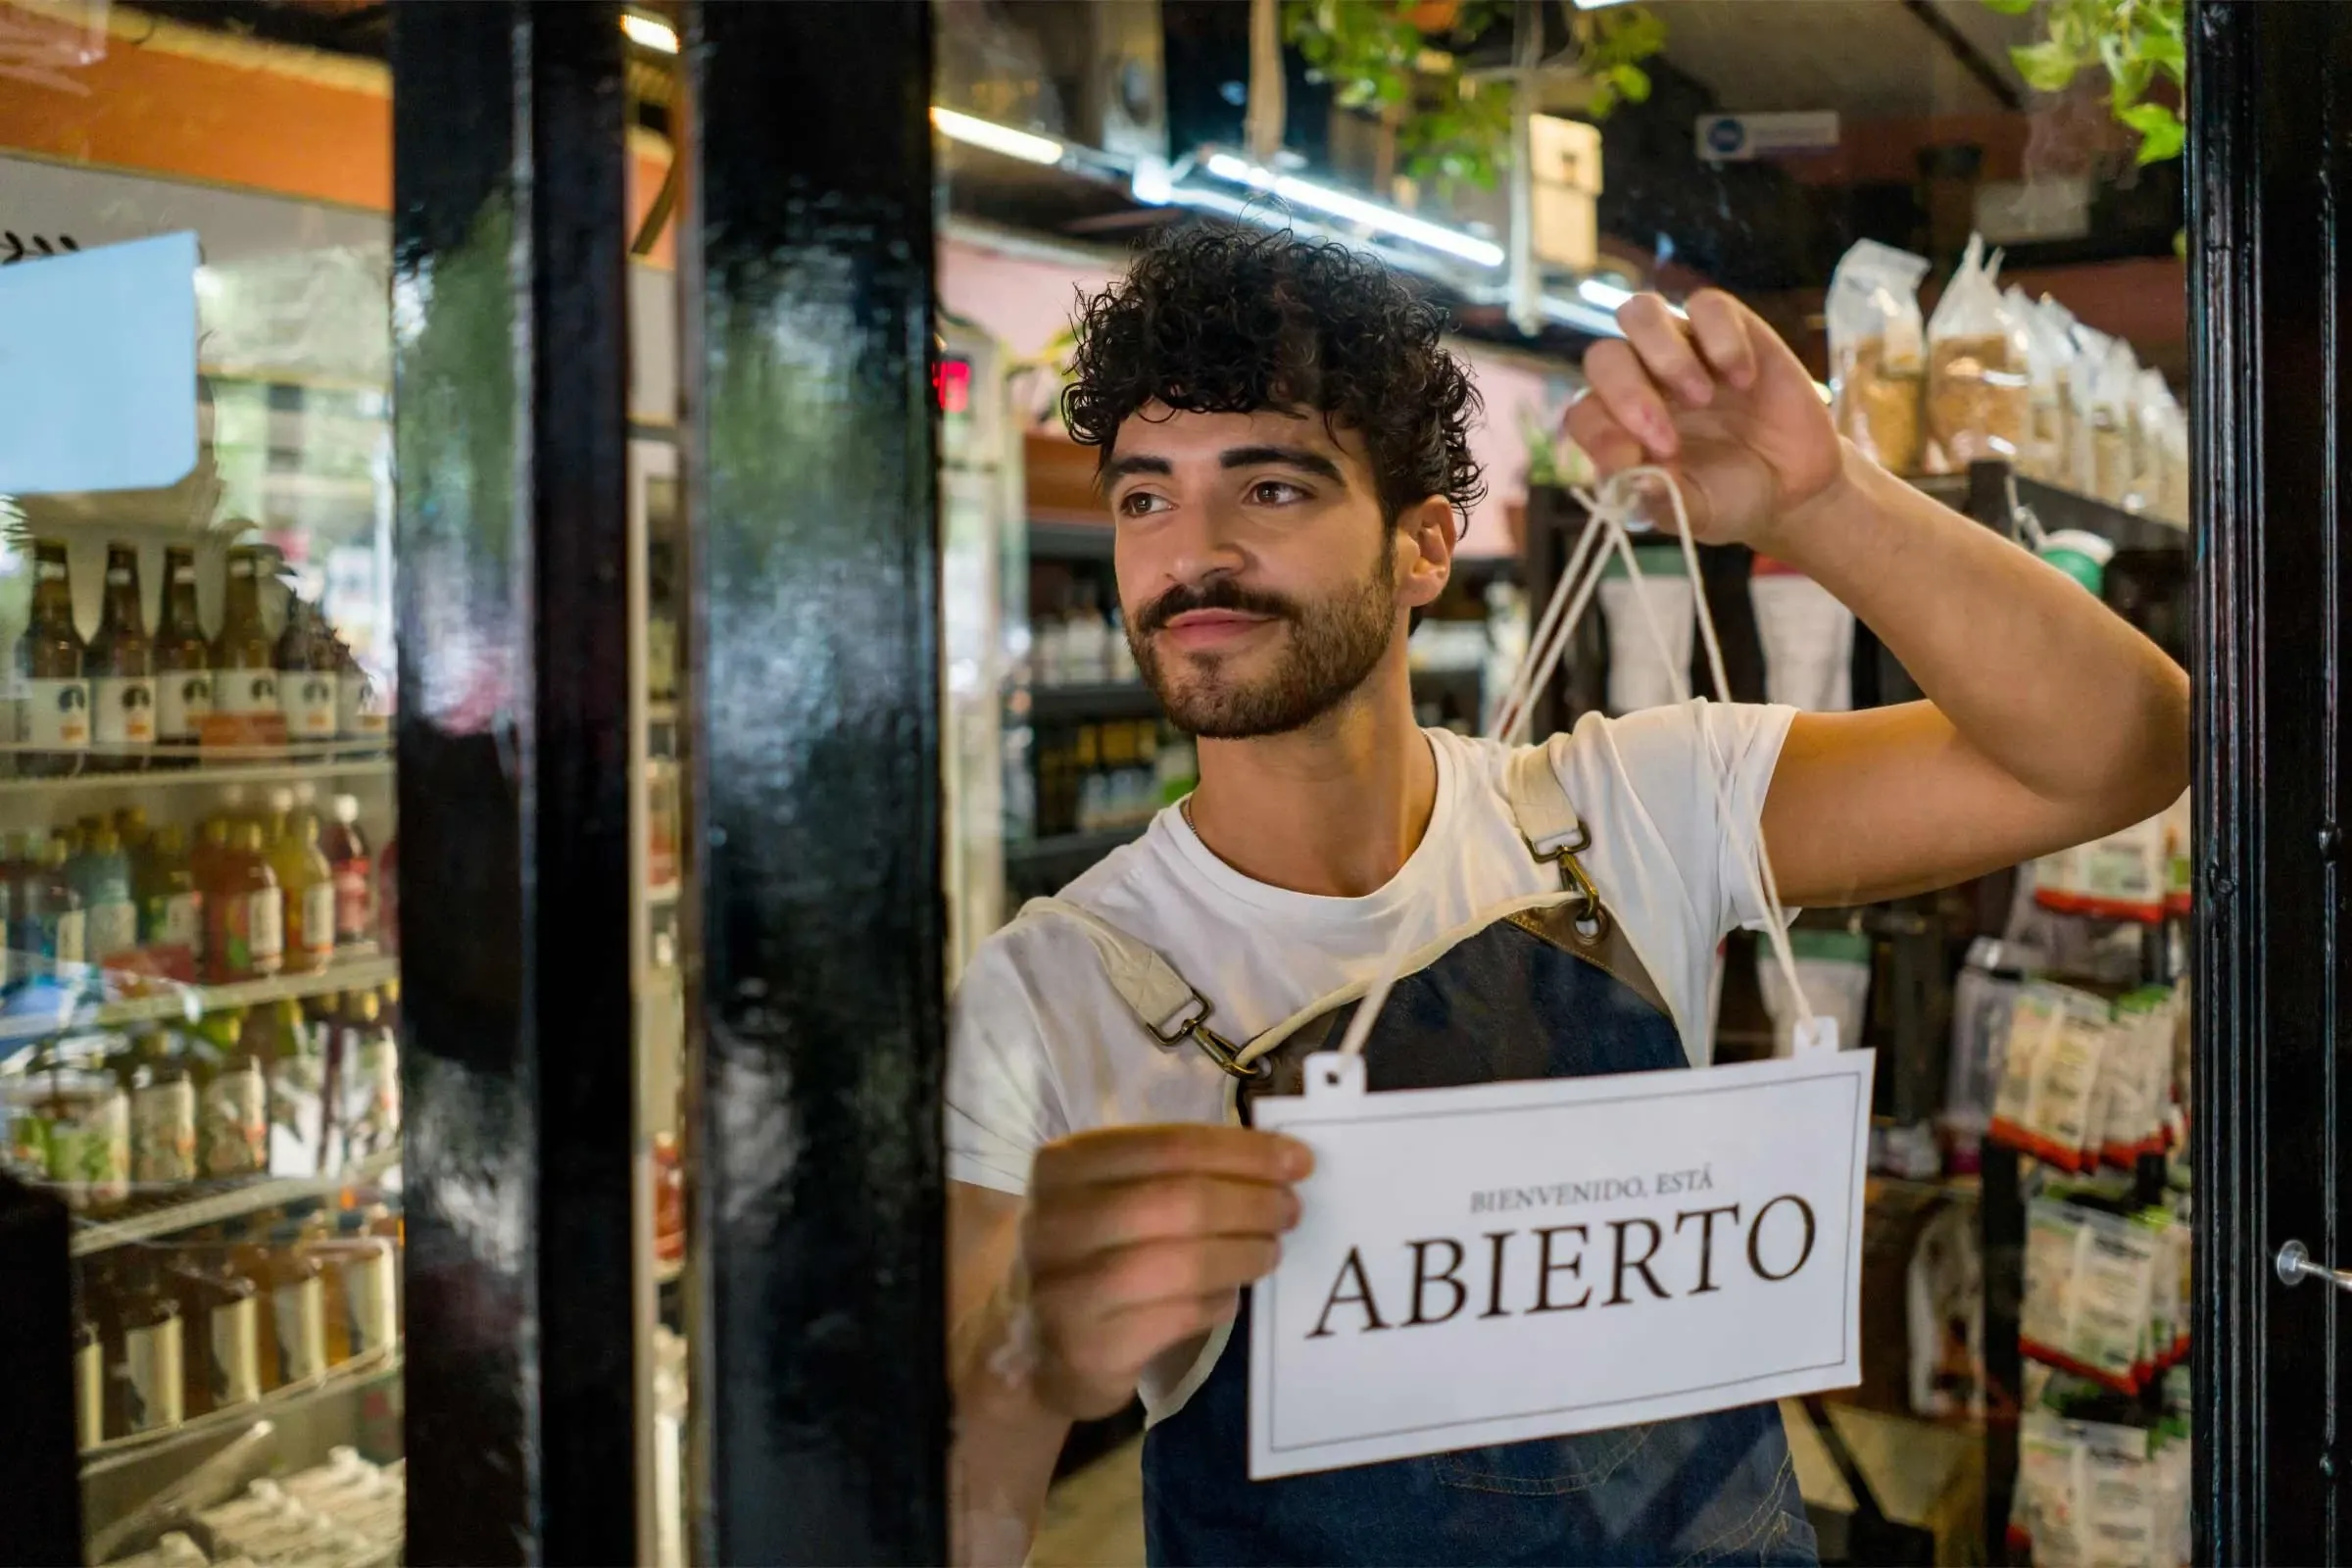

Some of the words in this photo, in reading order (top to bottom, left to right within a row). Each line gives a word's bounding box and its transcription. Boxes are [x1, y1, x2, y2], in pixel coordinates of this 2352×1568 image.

[1469, 1176, 1648, 1214] BIENVENIDO,
[1655, 1162, 1714, 1196] ESTÁ
[1303, 1194, 1817, 1341] ABIERTO
